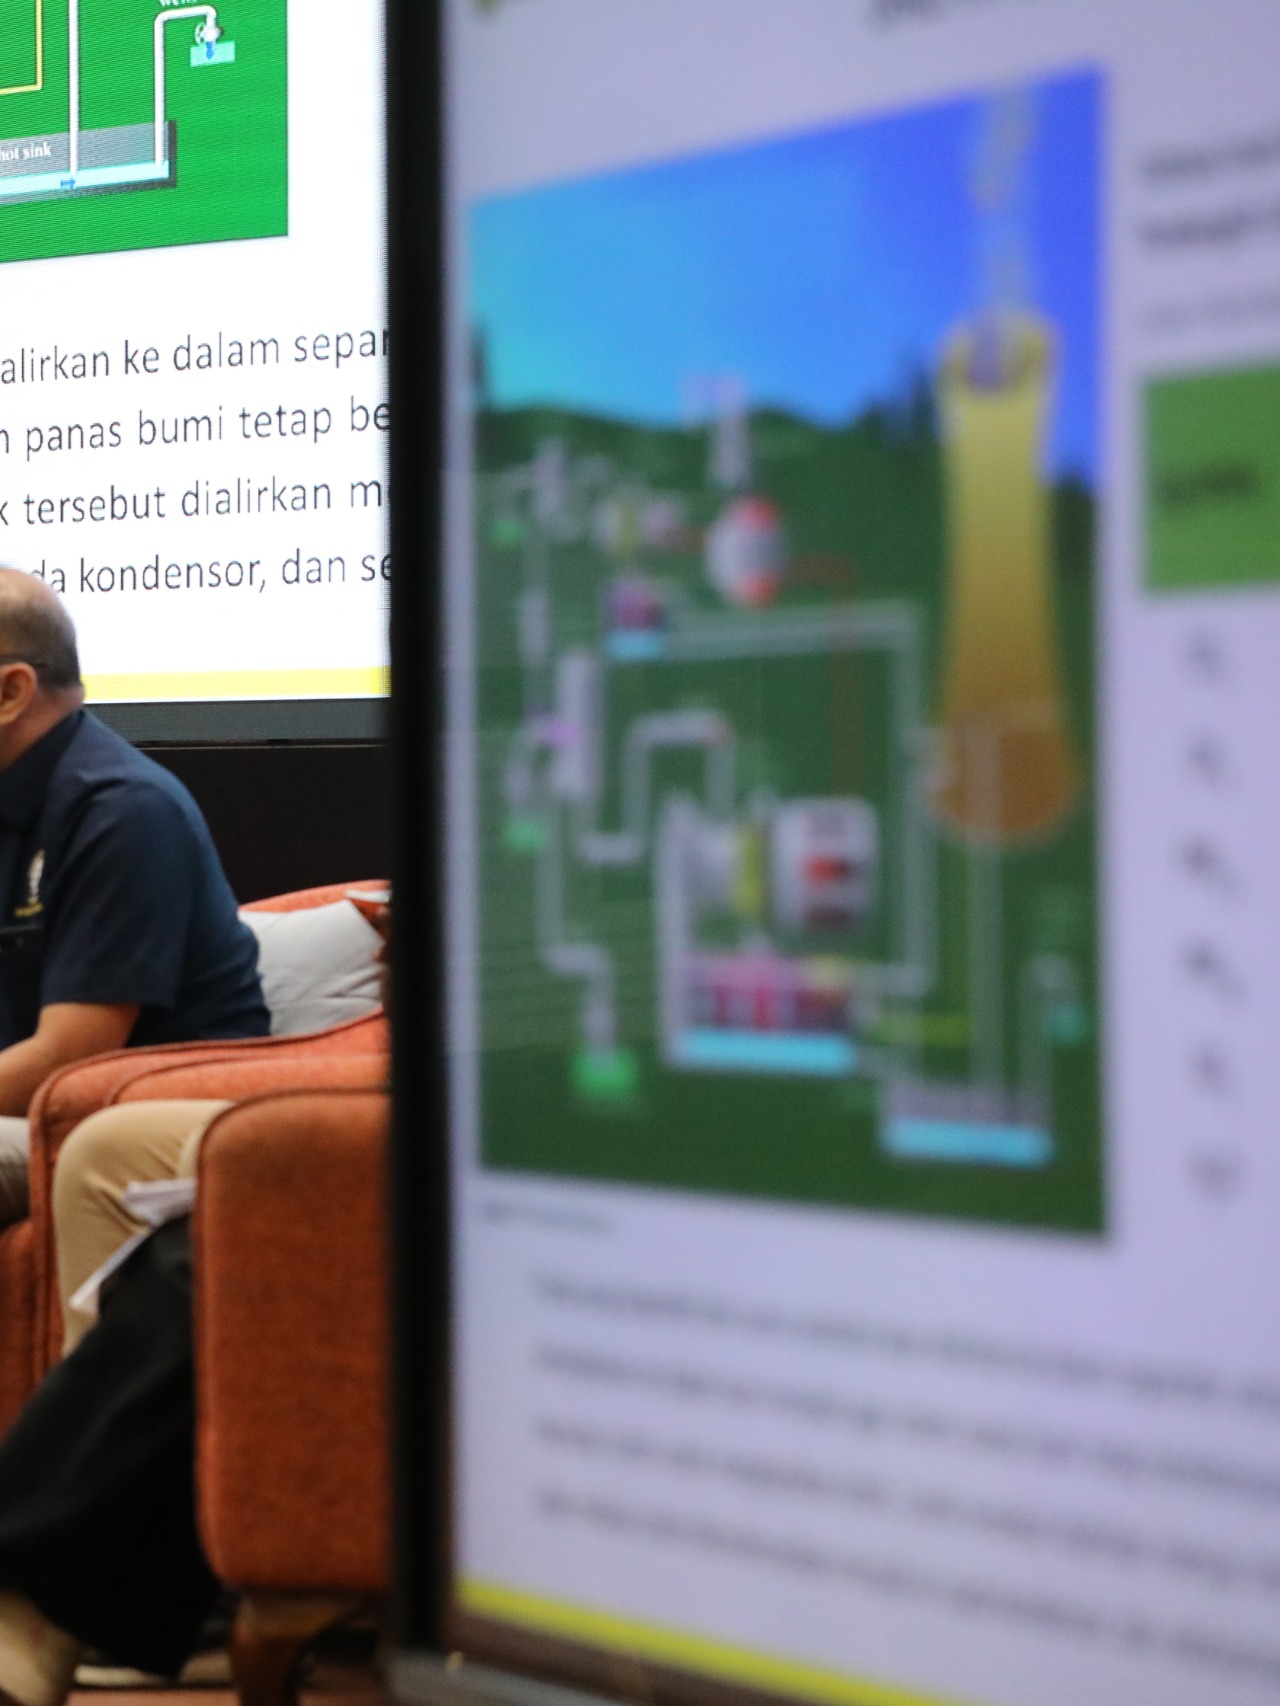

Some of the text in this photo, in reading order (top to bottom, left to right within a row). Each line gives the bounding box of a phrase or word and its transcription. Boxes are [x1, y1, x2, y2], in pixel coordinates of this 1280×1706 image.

[22, 141, 52, 160] sink
[125, 340, 159, 374] ke
[173, 335, 278, 371] dalam
[27, 422, 121, 460] panas
[139, 411, 221, 445] bumi
[240, 406, 331, 442] tetap
[24, 485, 165, 524] tersebut
[182, 478, 330, 516] dialirkan
[80, 555, 265, 592] kondensor,
[283, 549, 344, 584] dan
